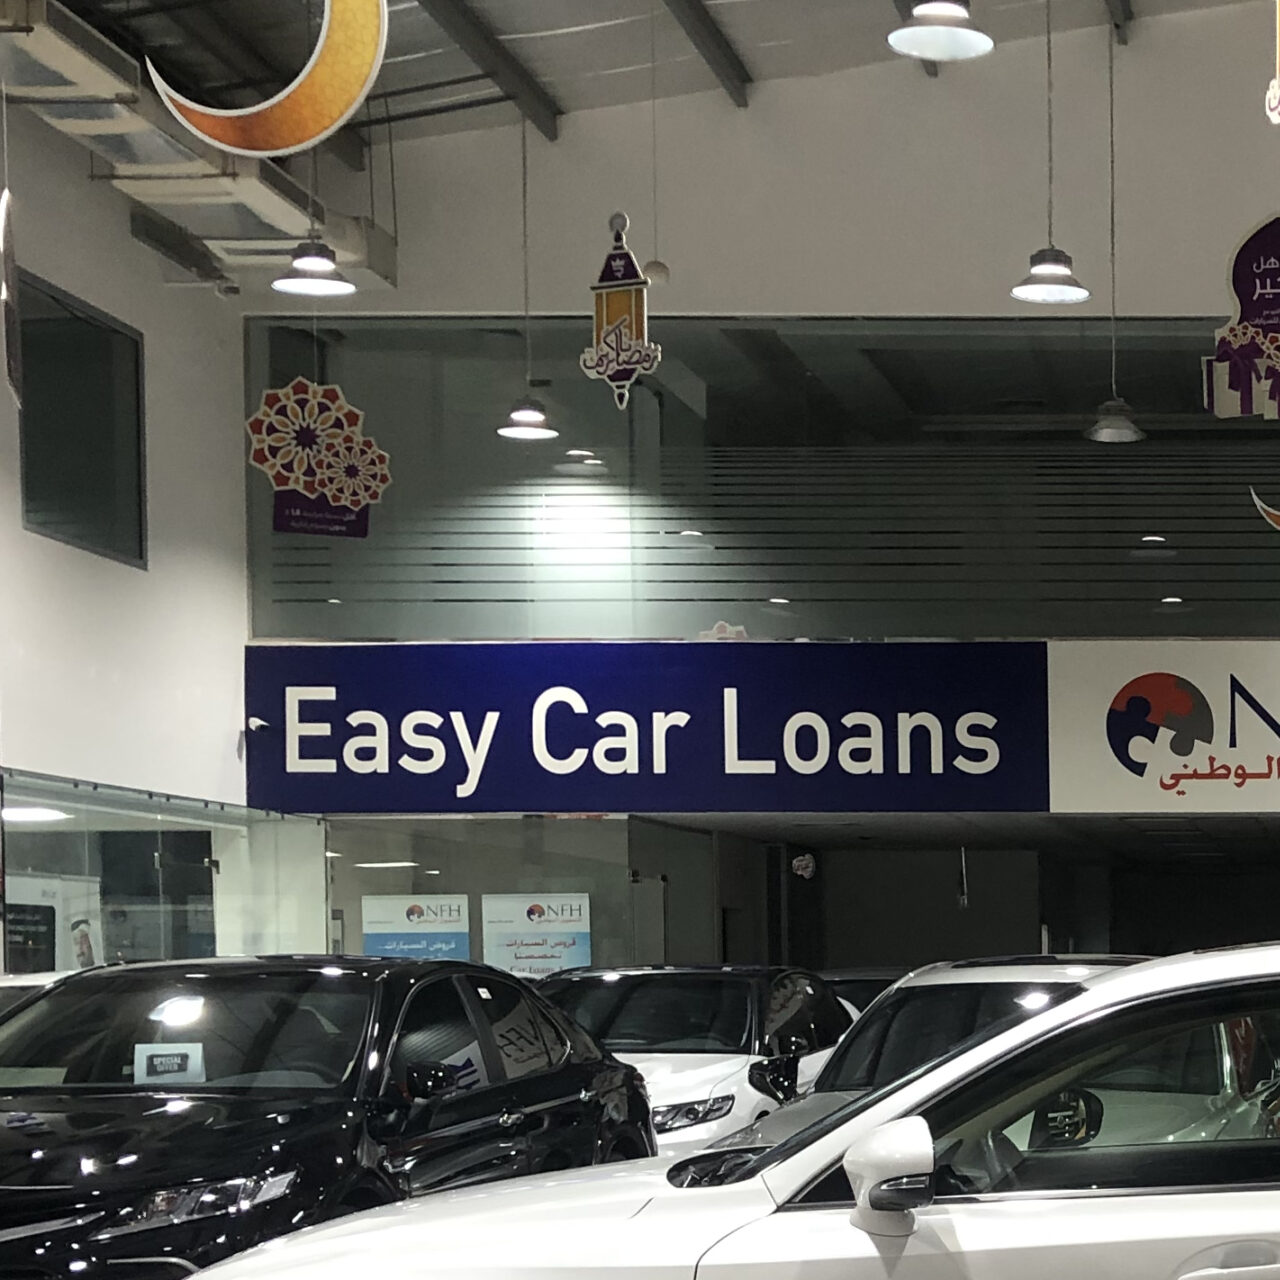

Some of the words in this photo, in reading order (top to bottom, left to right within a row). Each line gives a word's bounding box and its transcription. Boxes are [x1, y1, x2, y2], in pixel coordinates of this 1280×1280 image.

[284, 686, 499, 798] Easy
[532, 685, 690, 775] Car
[723, 686, 1000, 775] Loans
[426, 904, 461, 918] NFH
[547, 903, 582, 917] NFH
[153, 1056, 181, 1065] SPECIAL
